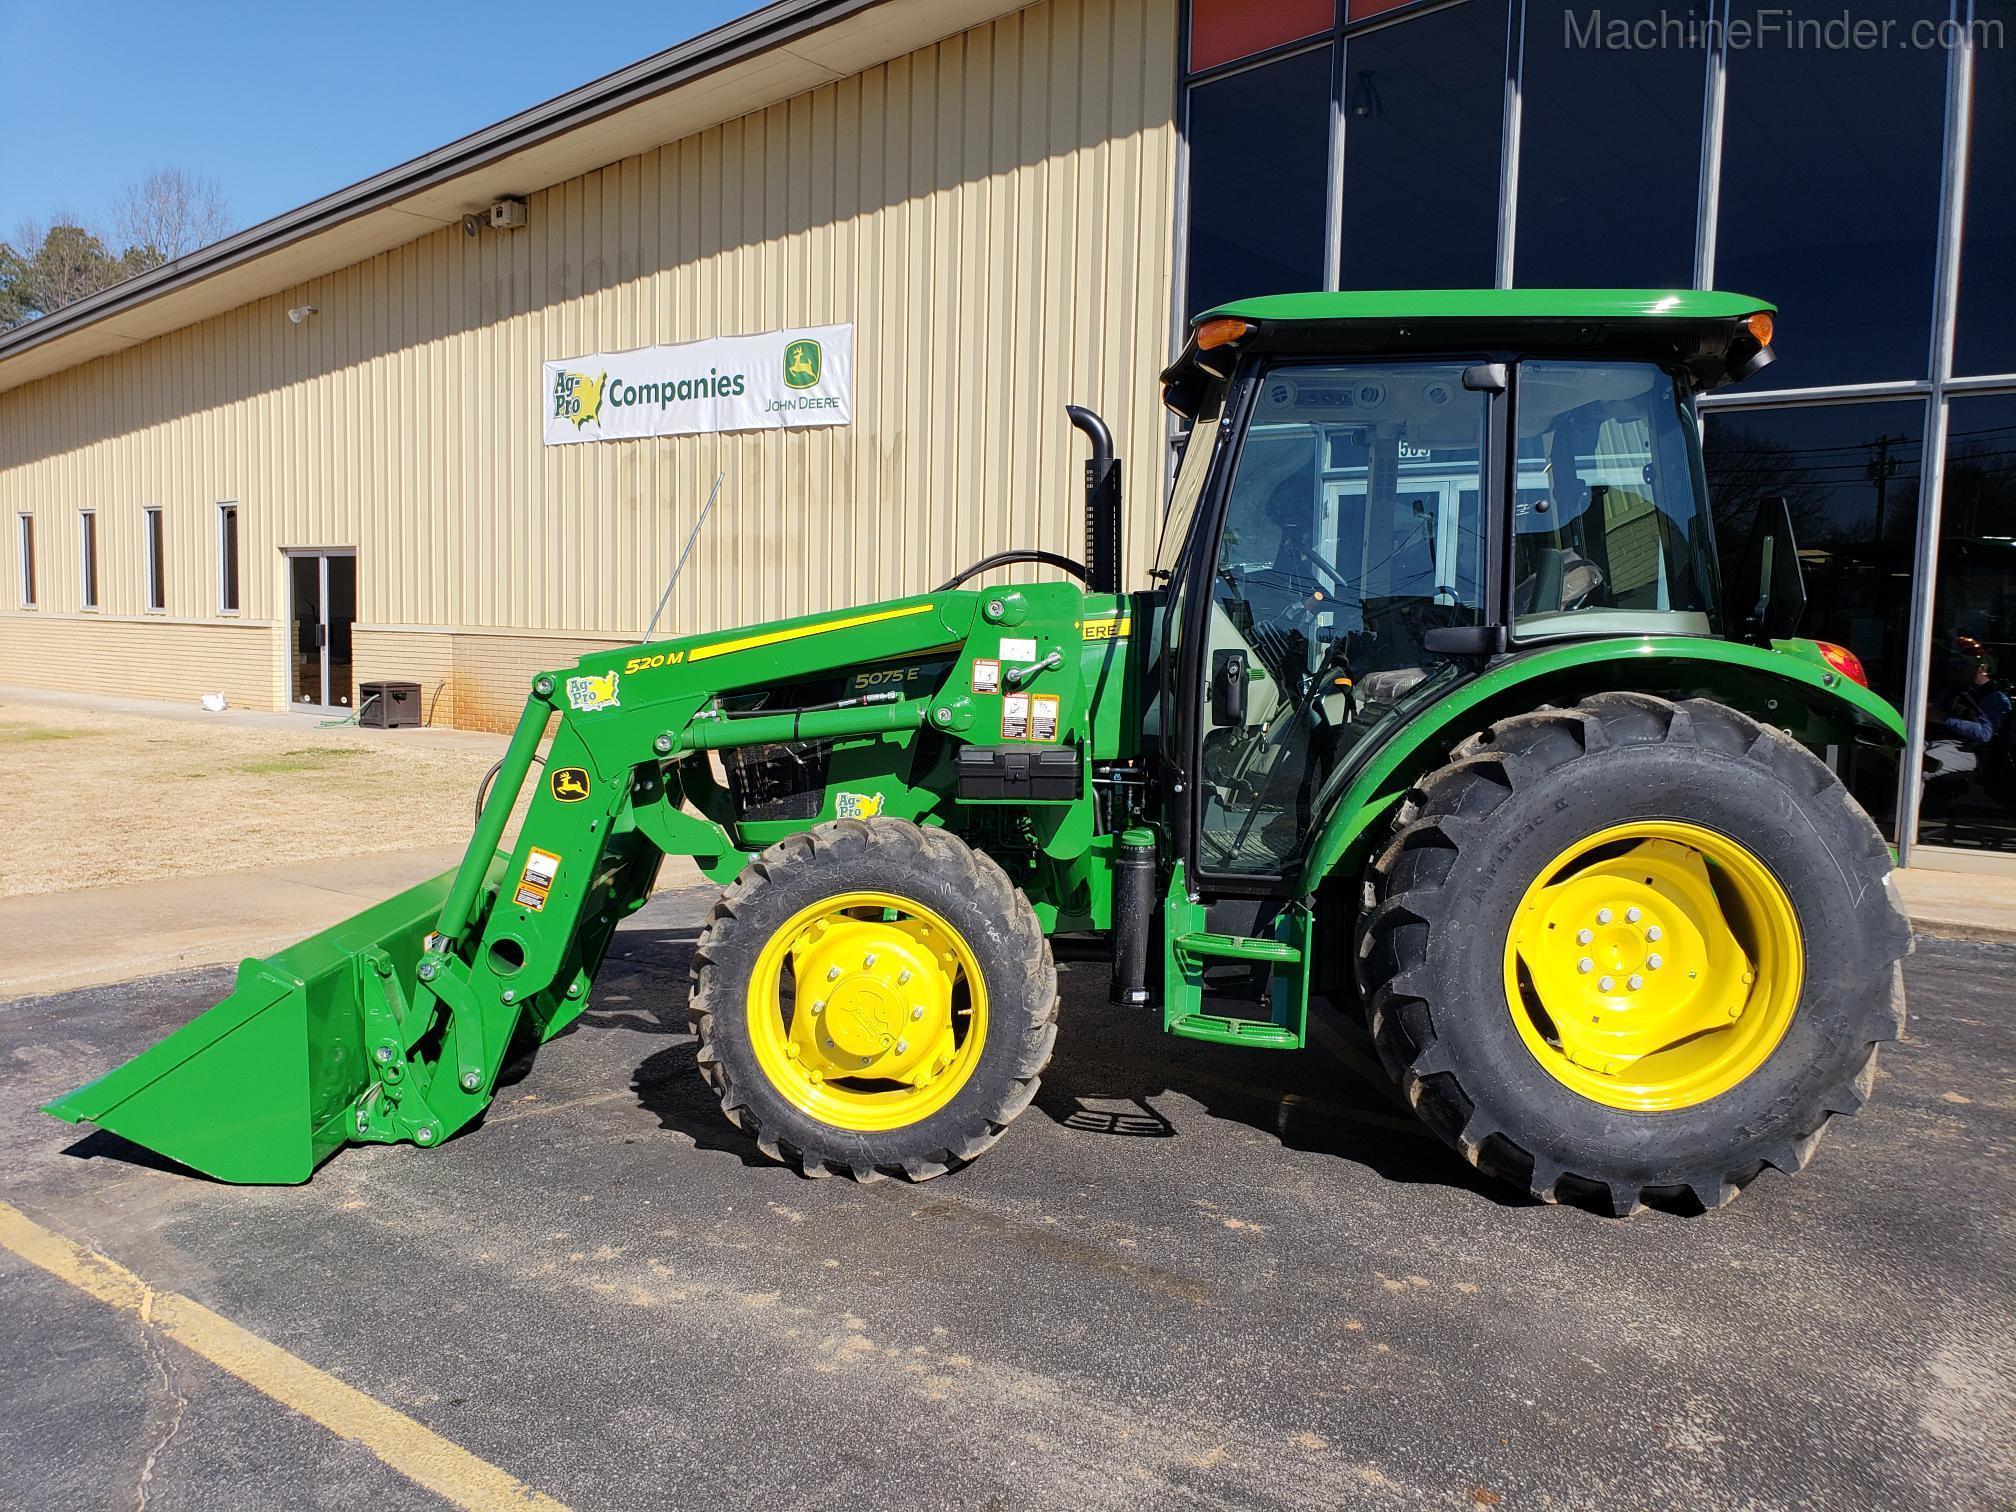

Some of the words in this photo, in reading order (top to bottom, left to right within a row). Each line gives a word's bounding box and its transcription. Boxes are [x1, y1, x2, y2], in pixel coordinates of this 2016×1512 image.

[609, 367, 745, 411] Companies
[554, 395, 581, 417] Pro
[764, 398, 797, 413] JOHN
[799, 396, 840, 410] DEERE
[624, 656, 665, 676] 520
[666, 650, 685, 667] M
[855, 669, 904, 689] 5075
[907, 667, 920, 680] E
[572, 690, 597, 705] Pro
[839, 806, 862, 818] Pro
